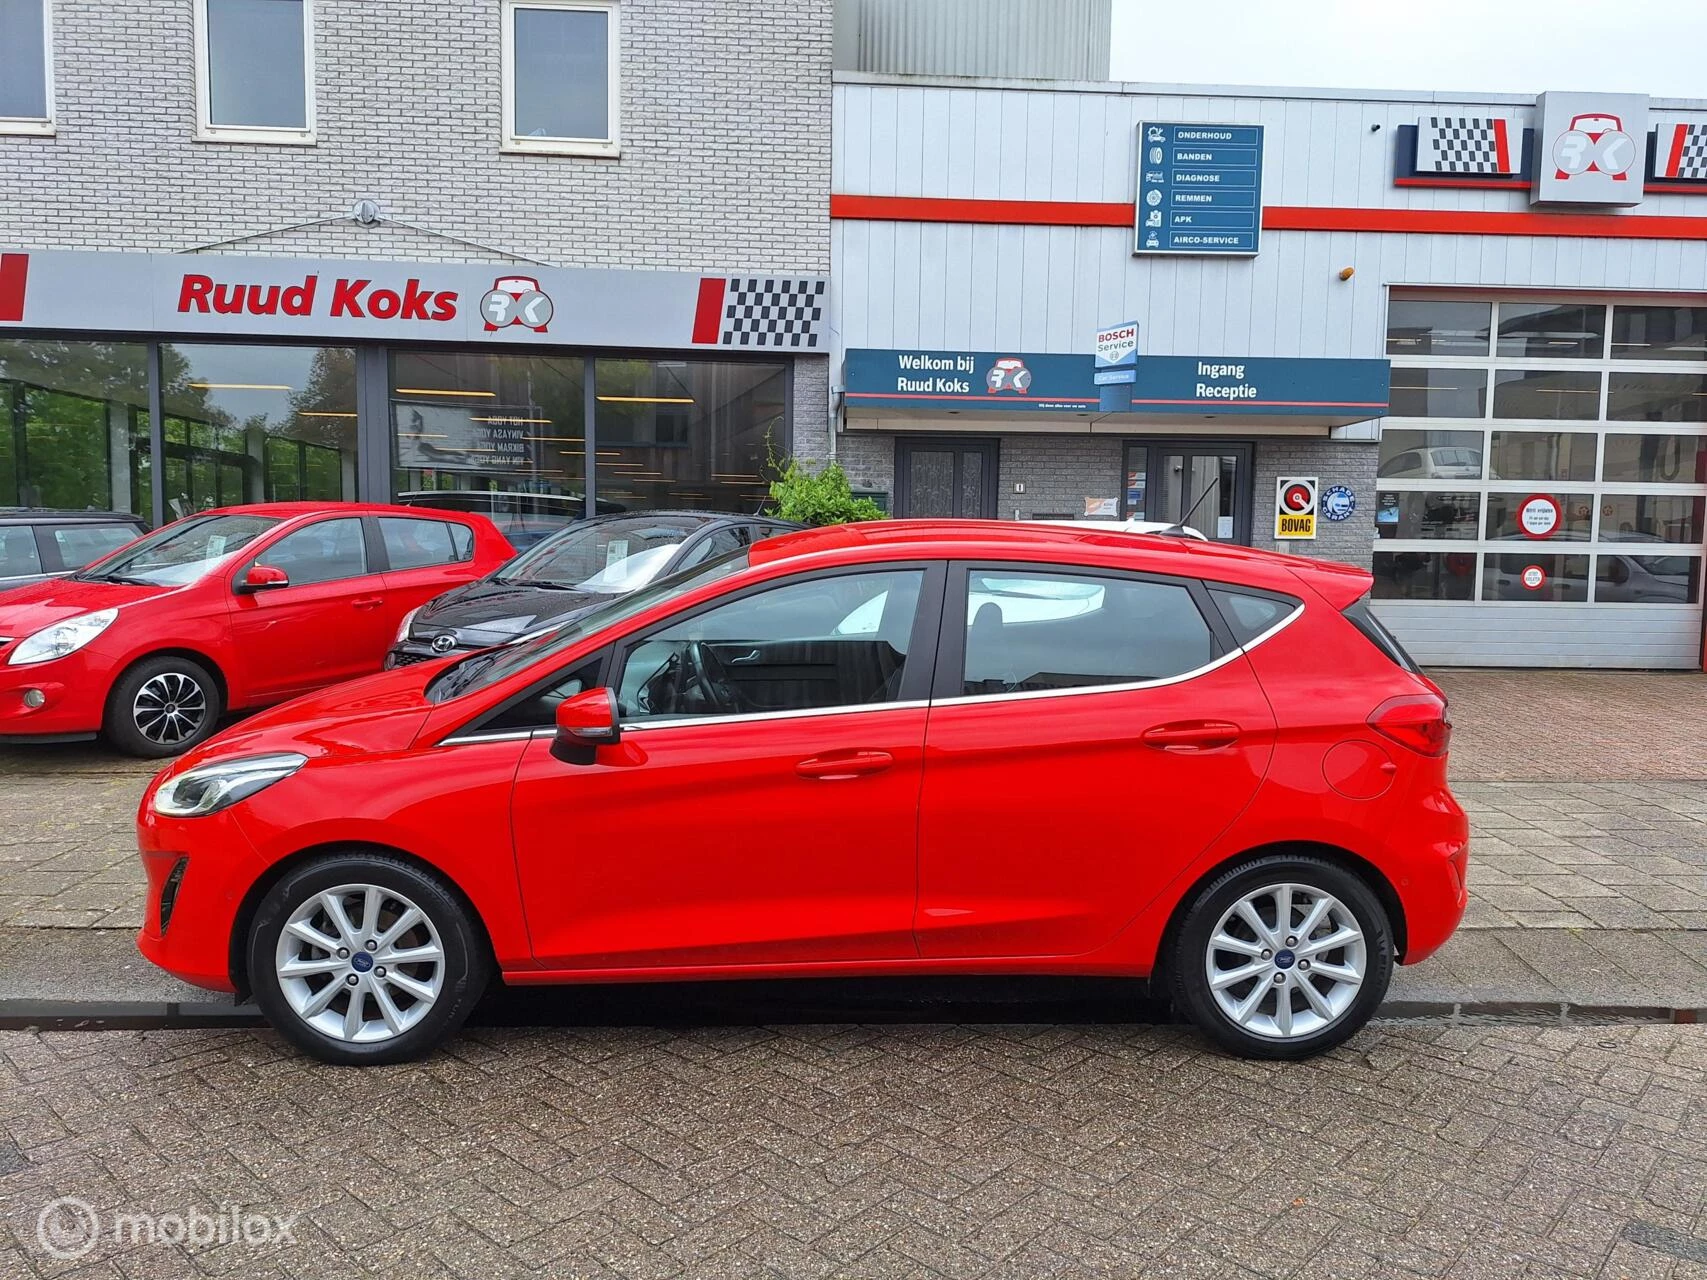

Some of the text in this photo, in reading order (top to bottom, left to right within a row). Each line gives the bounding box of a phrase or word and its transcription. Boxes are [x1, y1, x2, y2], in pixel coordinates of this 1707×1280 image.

[1178, 131, 1232, 140] ONDERHOUD
[1176, 174, 1220, 182] DIAGNOSE
[1173, 236, 1239, 244] AIRCO-SERVICE
[177, 273, 459, 322] Ruud Koks
[1098, 328, 1135, 343] BOSCH
[1097, 340, 1135, 352] Service
[898, 355, 974, 374] Welkom bij
[1197, 361, 1245, 379] Ingang
[897, 377, 970, 393] Ruud Koks
[1196, 383, 1257, 400] Receptie
[1322, 486, 1355, 501] SCHADE
[1281, 518, 1311, 532] BOVAG
